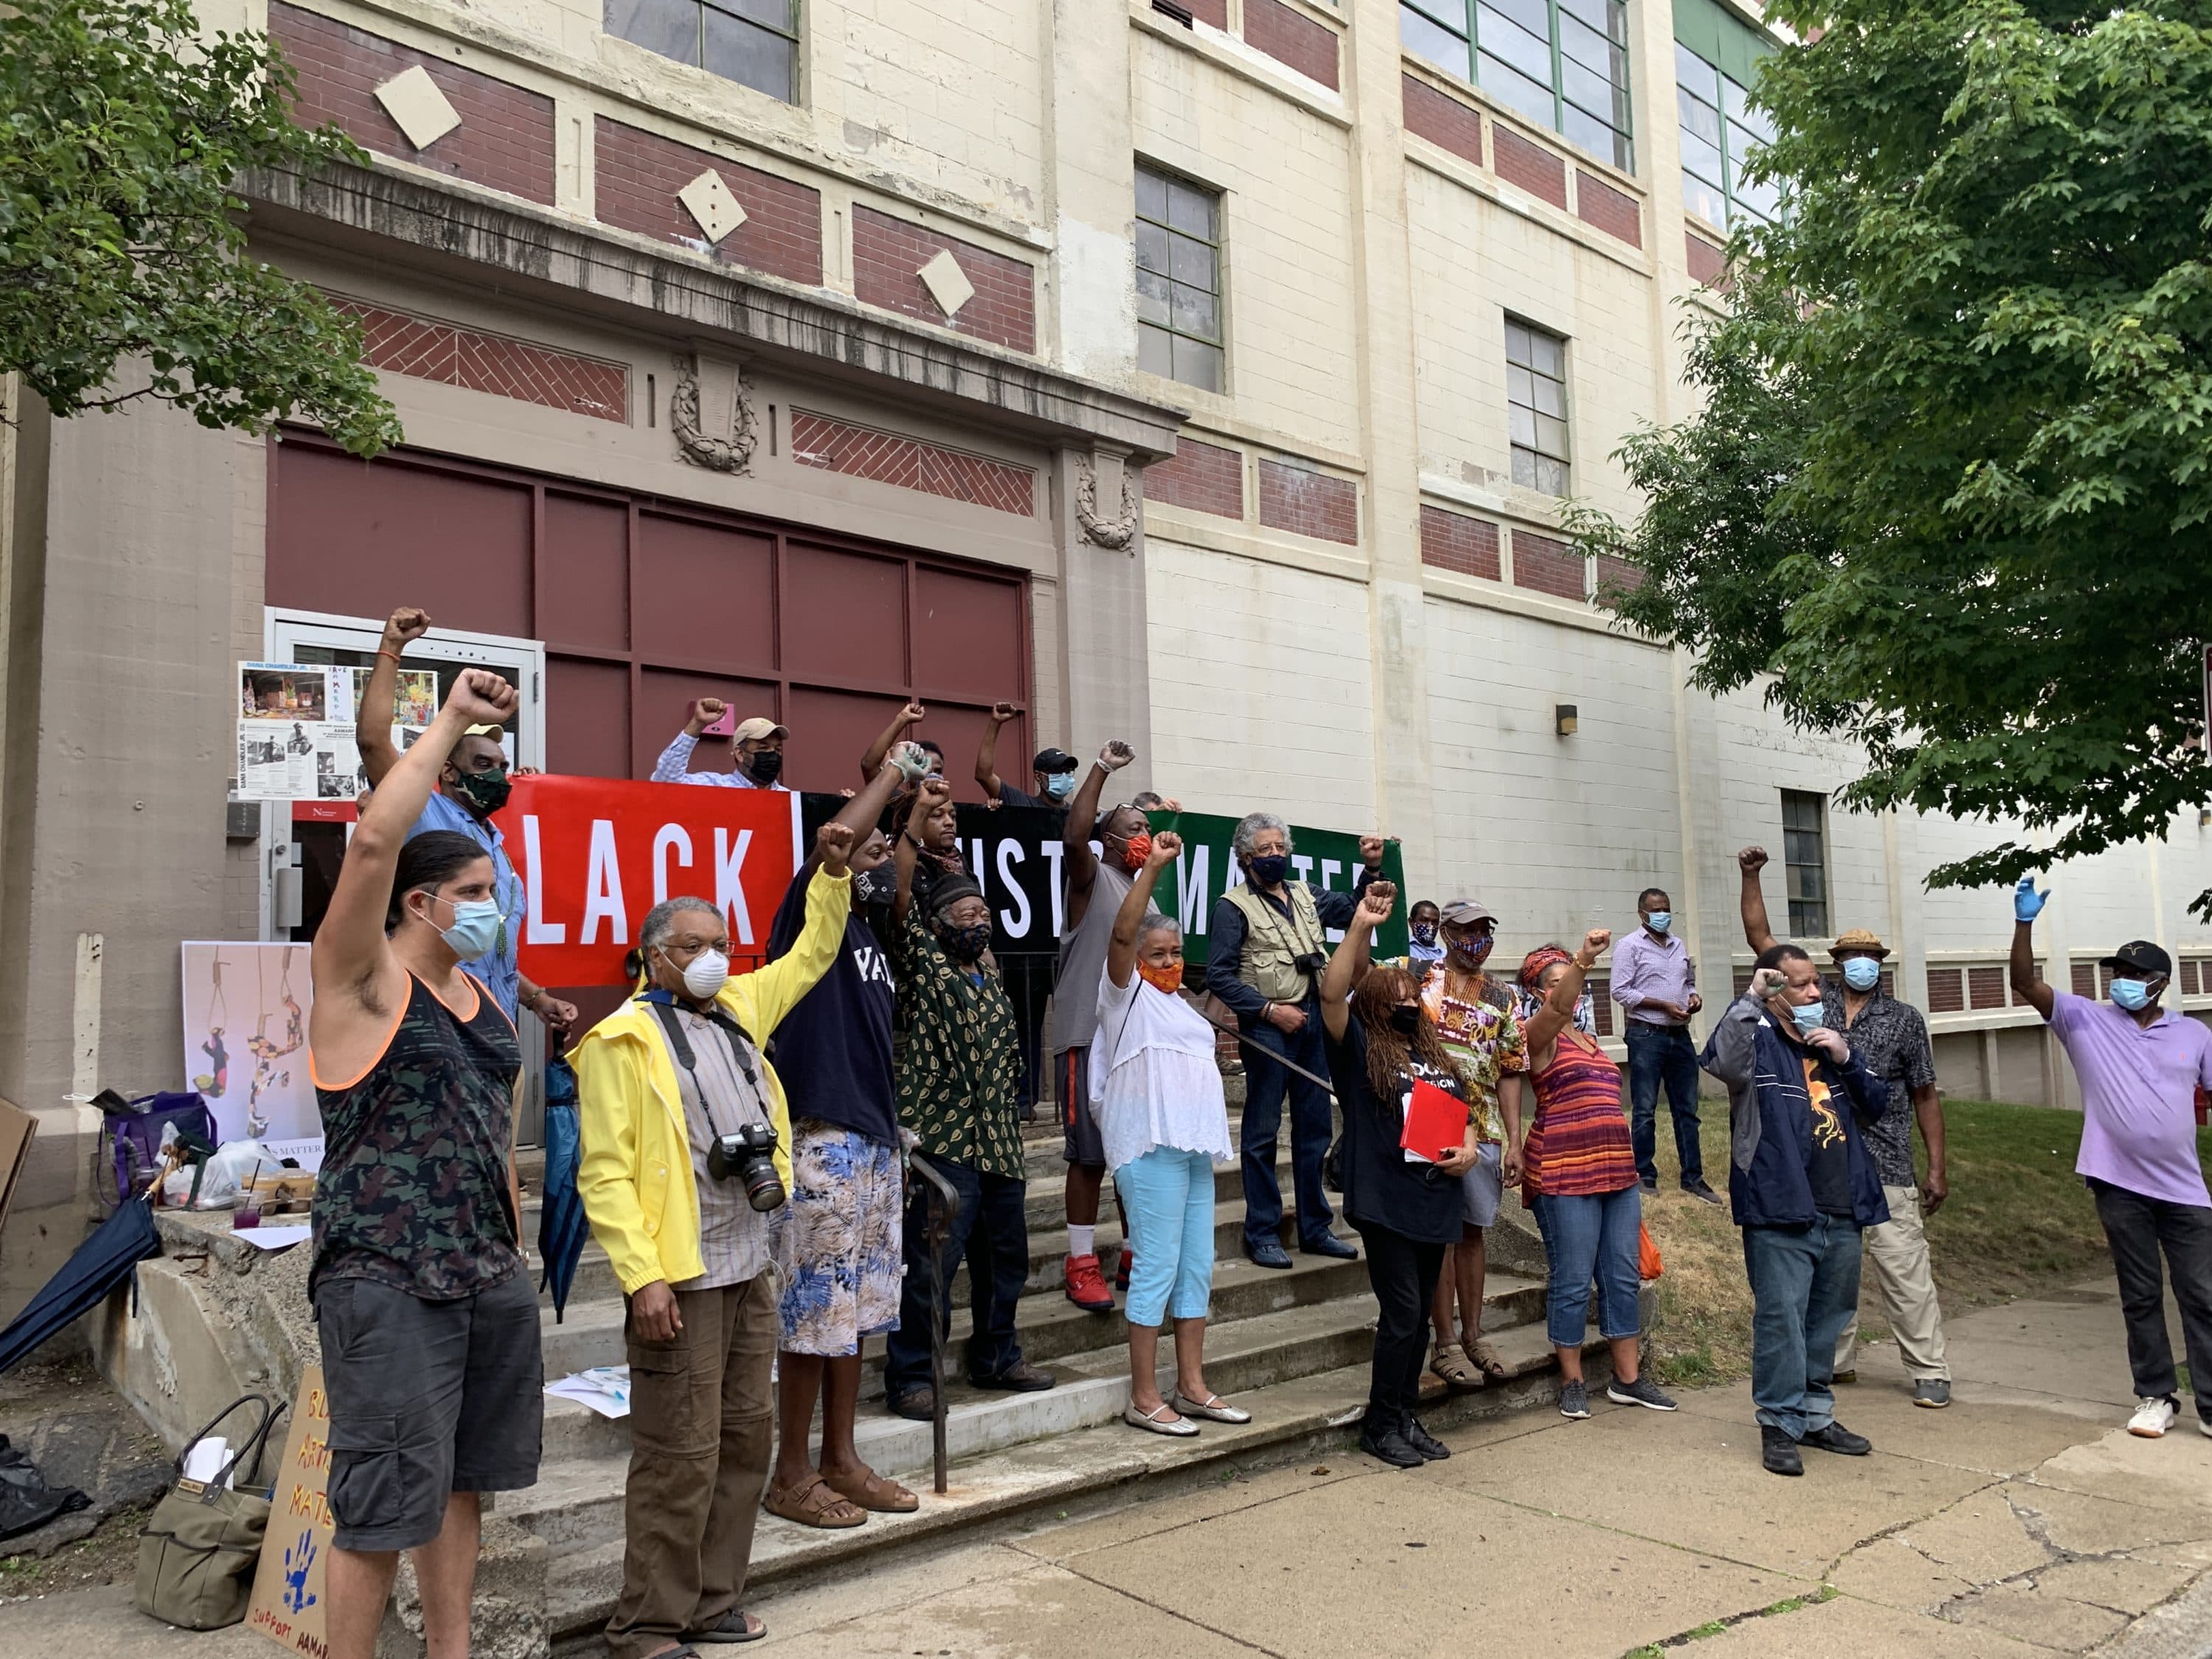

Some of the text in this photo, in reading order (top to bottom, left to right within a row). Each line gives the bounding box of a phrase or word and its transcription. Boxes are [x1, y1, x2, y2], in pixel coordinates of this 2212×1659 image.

[522, 815, 755, 945] LACK
[853, 947, 895, 993] YAL
[253, 1607, 330, 1659] SUPPORT AAMAR
